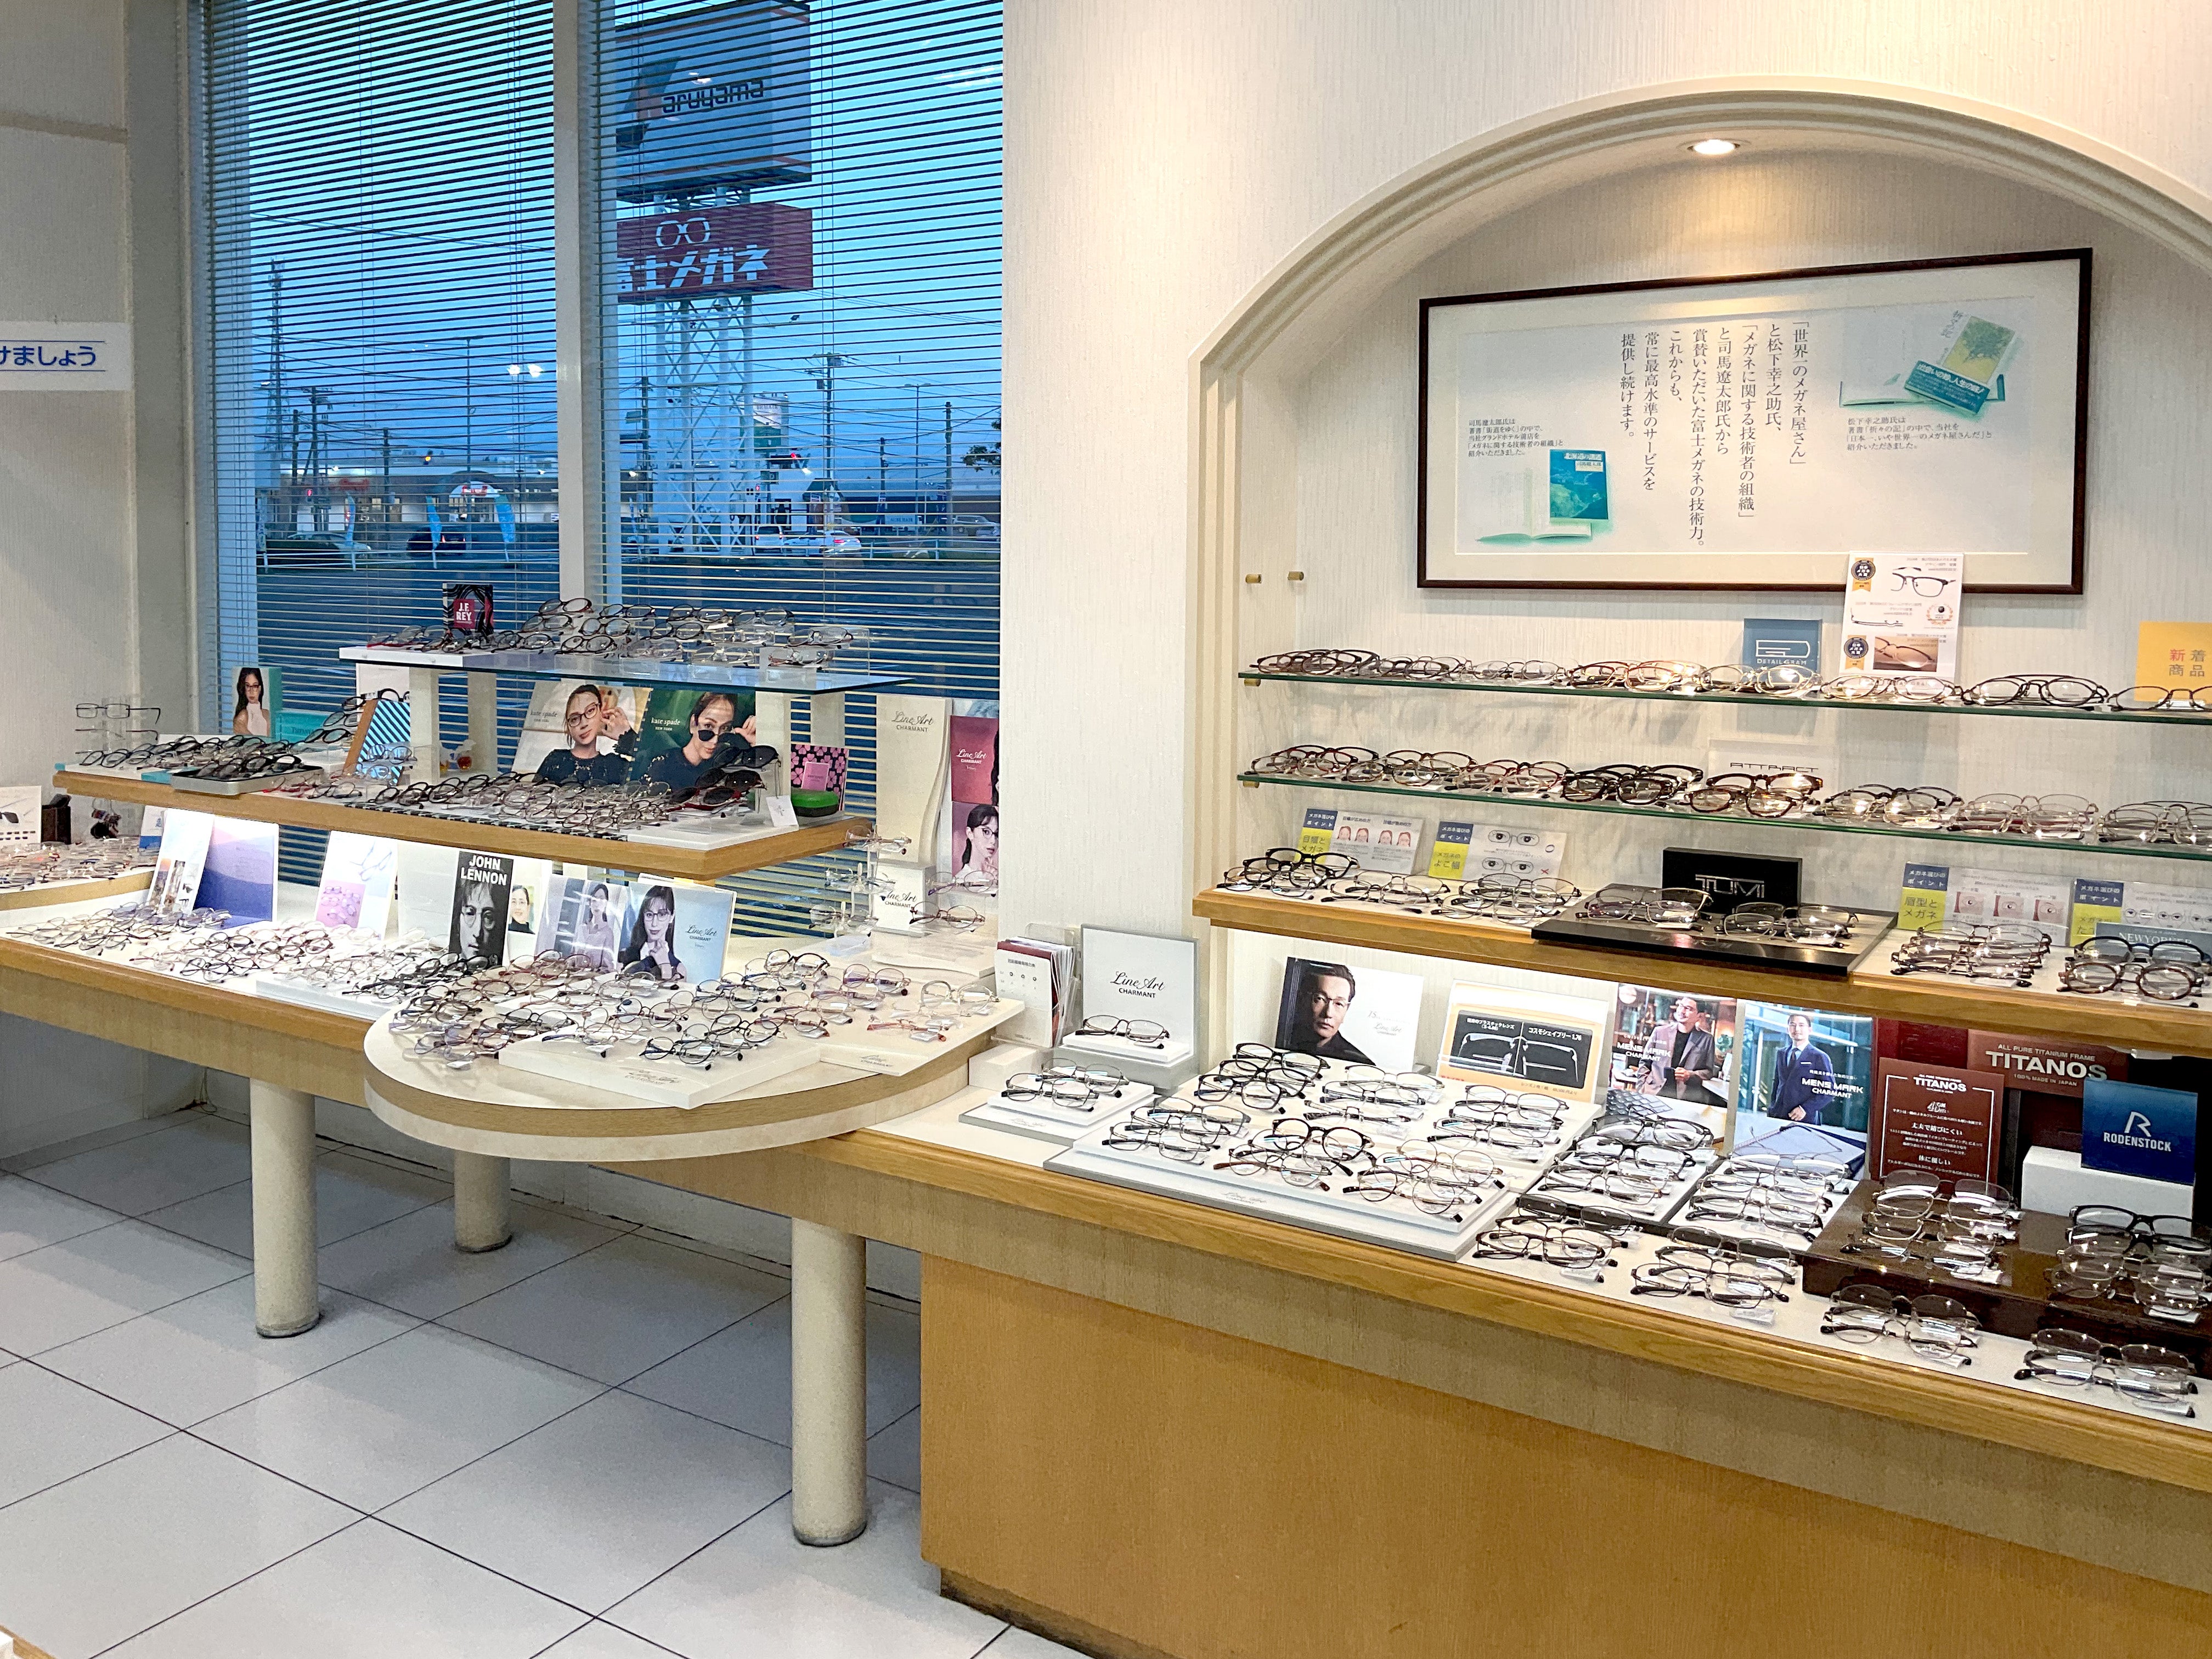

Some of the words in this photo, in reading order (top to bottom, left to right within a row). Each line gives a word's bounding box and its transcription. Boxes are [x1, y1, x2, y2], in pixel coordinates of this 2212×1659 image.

[1669, 330, 1684, 401] これからも、
[1620, 333, 1636, 437] 提供し続けます。
[1765, 324, 1783, 431] と松下幸之助氏、
[1716, 328, 1731, 455] と司馬遼太郎氏から
[1790, 321, 1809, 464] 「世界一のメガネ屋さん」
[1644, 332, 1660, 490] 常に最高水準のサービスを
[1738, 325, 1758, 517] 「メガネに関する技術者の組織」
[1689, 329, 1708, 546] 賞賛いただいた富士メガネの技術力。
[456, 611, 472, 621] REY
[2169, 648, 2206, 662] 新着
[2169, 664, 2205, 677] 商品
[891, 710, 913, 725] Line
[913, 714, 934, 725] Art
[896, 724, 929, 732] CHARMANT
[956, 748, 973, 758] Line
[972, 750, 988, 759] Art
[1730, 763, 1819, 772] ATTRACT
[469, 855, 501, 871] JOHN
[460, 867, 507, 885] LENNON
[1908, 879, 1945, 887] ポイント
[1695, 874, 1764, 898] TUMI
[2081, 885, 2120, 894] メガネ選びの
[2080, 894, 2120, 903] ポイント
[1904, 909, 1937, 919] メガネ
[685, 924, 703, 936] Line
[703, 927, 718, 936] Art
[1110, 971, 1139, 989] Line
[1137, 977, 1165, 990] Art
[1119, 988, 1156, 998] CHARMANT
[1617, 1042, 1643, 1052] MENS
[1646, 1047, 1671, 1058] MARK
[1626, 1051, 1661, 1061] CHARMANT
[2035, 1048, 2068, 1059] TITANIUM
[2069, 1053, 2095, 1062] FRAME
[1985, 1051, 2107, 1081] TITANOS
[1802, 1077, 1832, 1089] MENS
[1833, 1082, 1863, 1093] MARK
[1913, 1076, 1967, 1092] TITANOS
[2058, 1078, 2077, 1086] JAPAN
[1812, 1087, 1852, 1098] CHARMANT
[2103, 1132, 2171, 1152] RODENSTOCK
